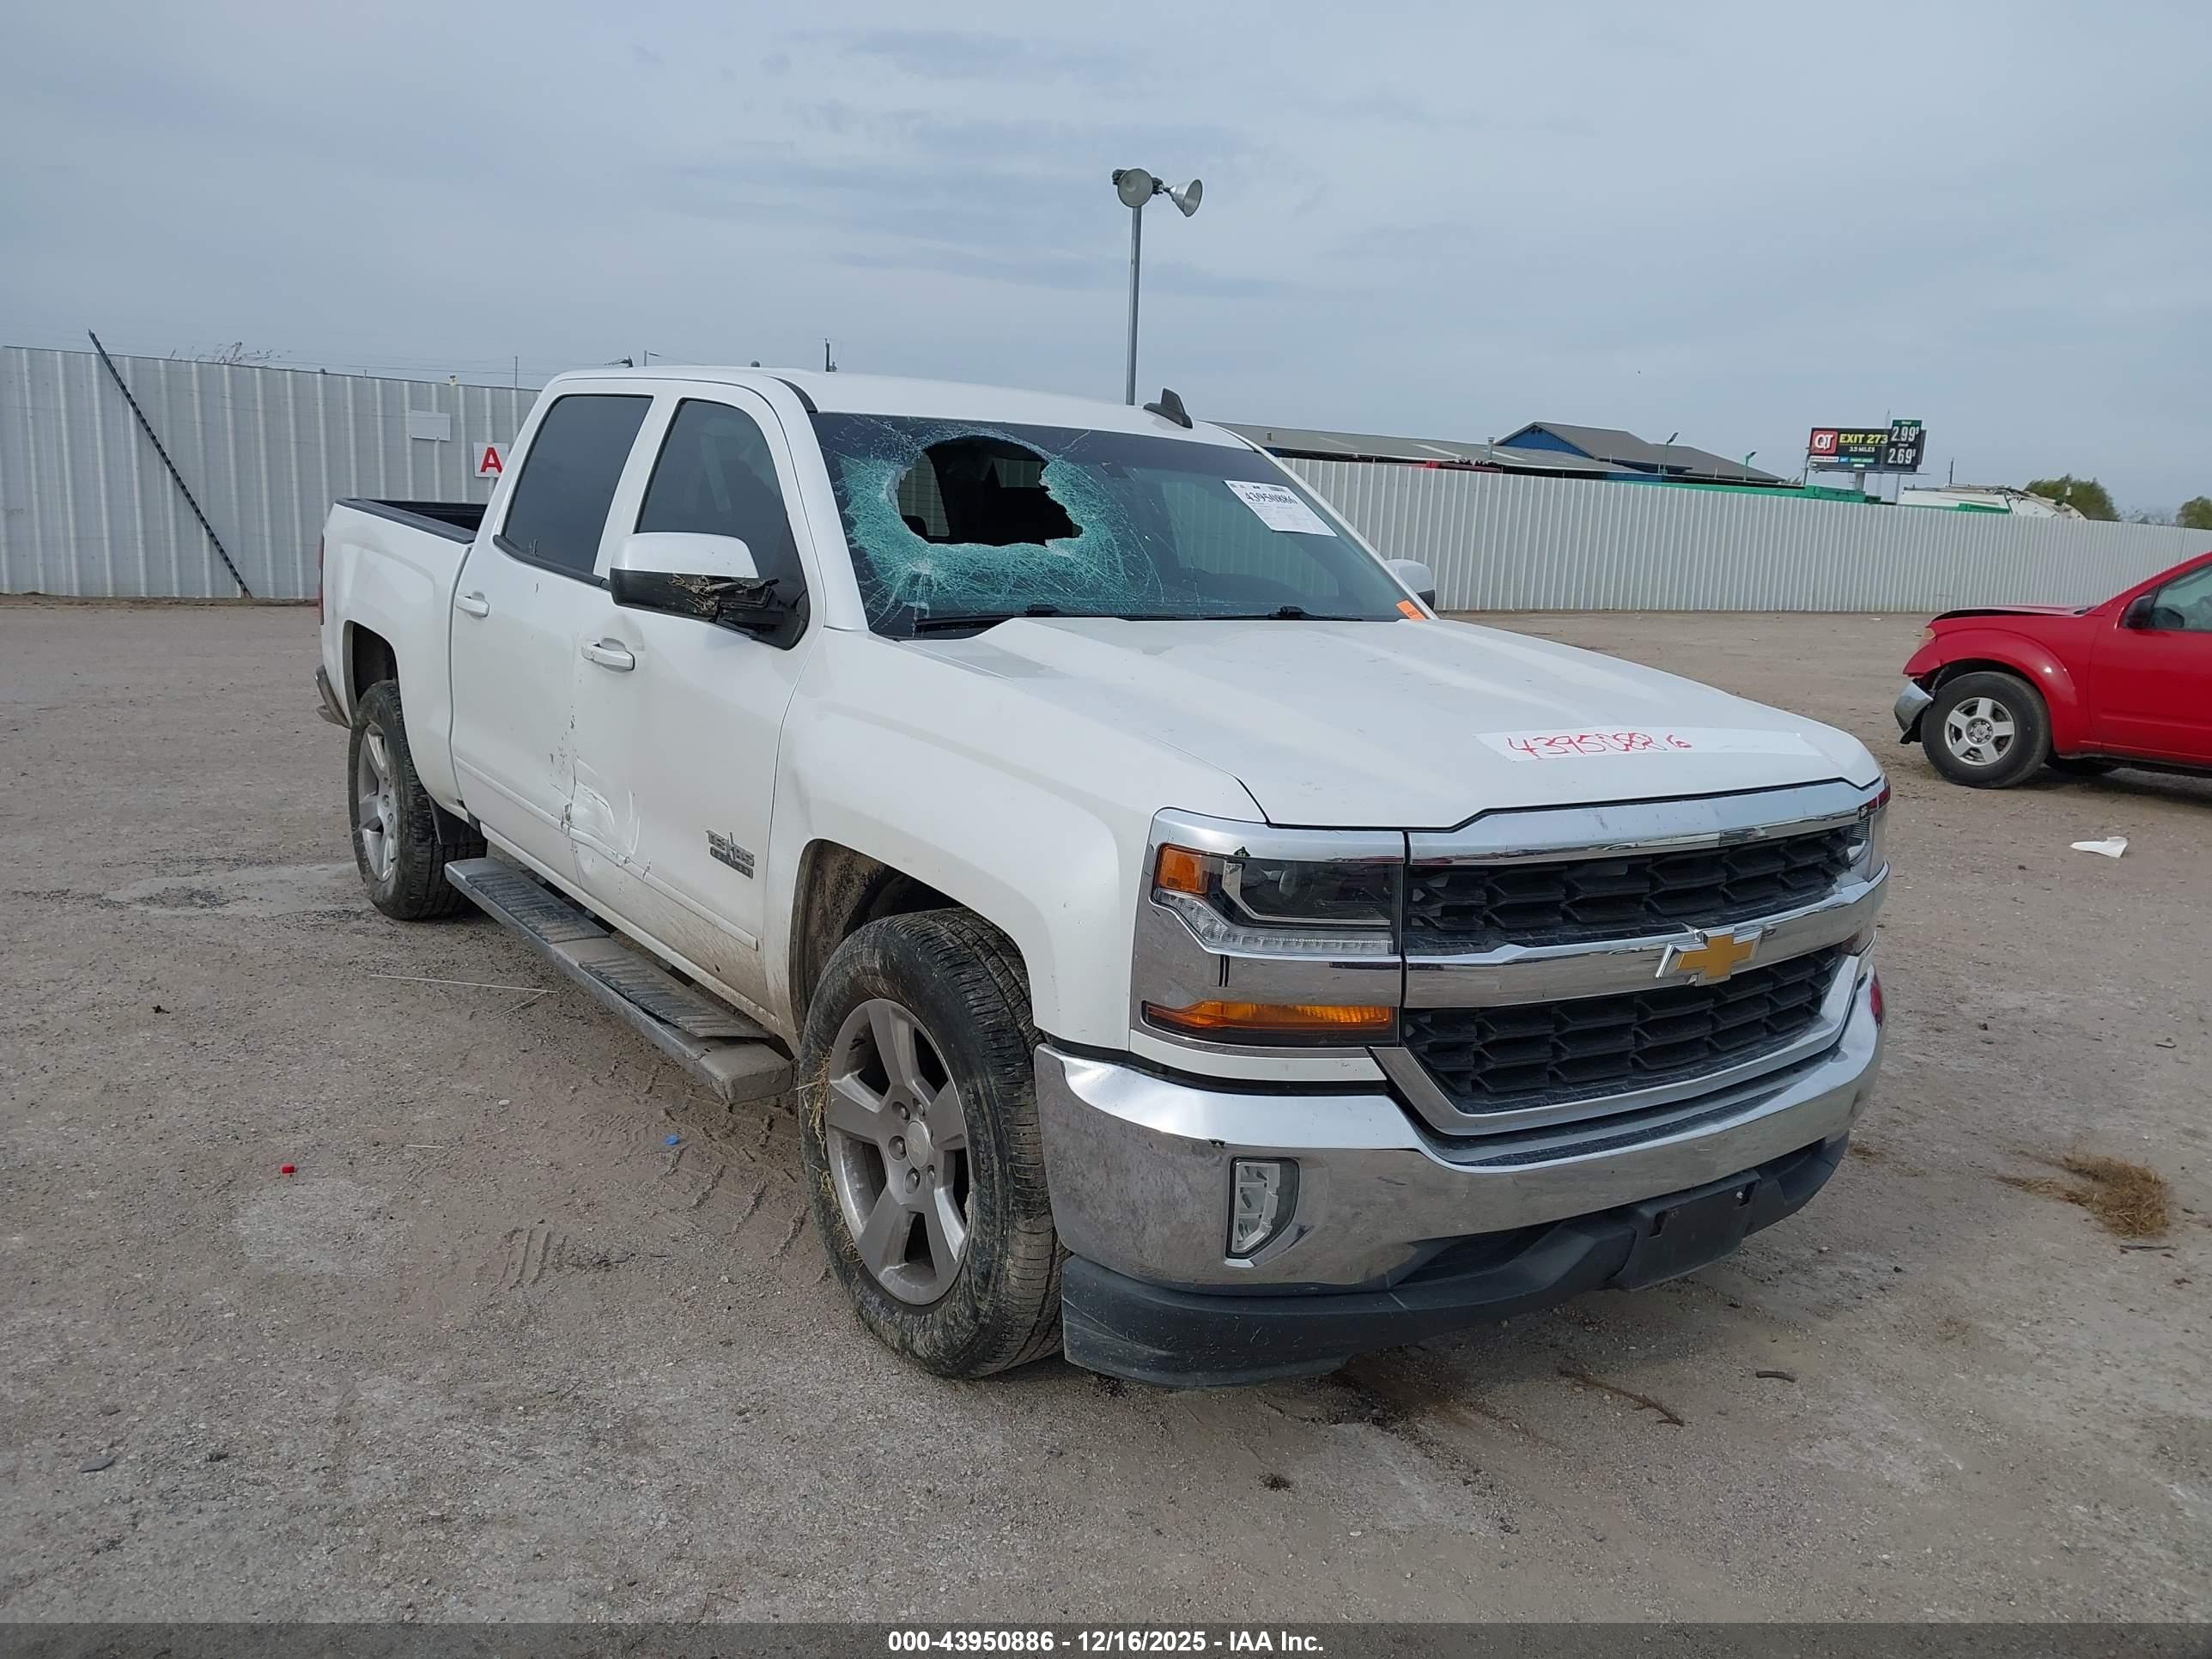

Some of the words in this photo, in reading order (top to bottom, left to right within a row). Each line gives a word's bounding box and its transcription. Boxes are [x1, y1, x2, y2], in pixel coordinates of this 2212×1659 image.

[1814, 434, 1833, 451] QT
[1839, 434, 1865, 443] EXIT
[1866, 434, 1888, 444] 273
[480, 447, 503, 473] A
[1245, 492, 1298, 505] 43950886
